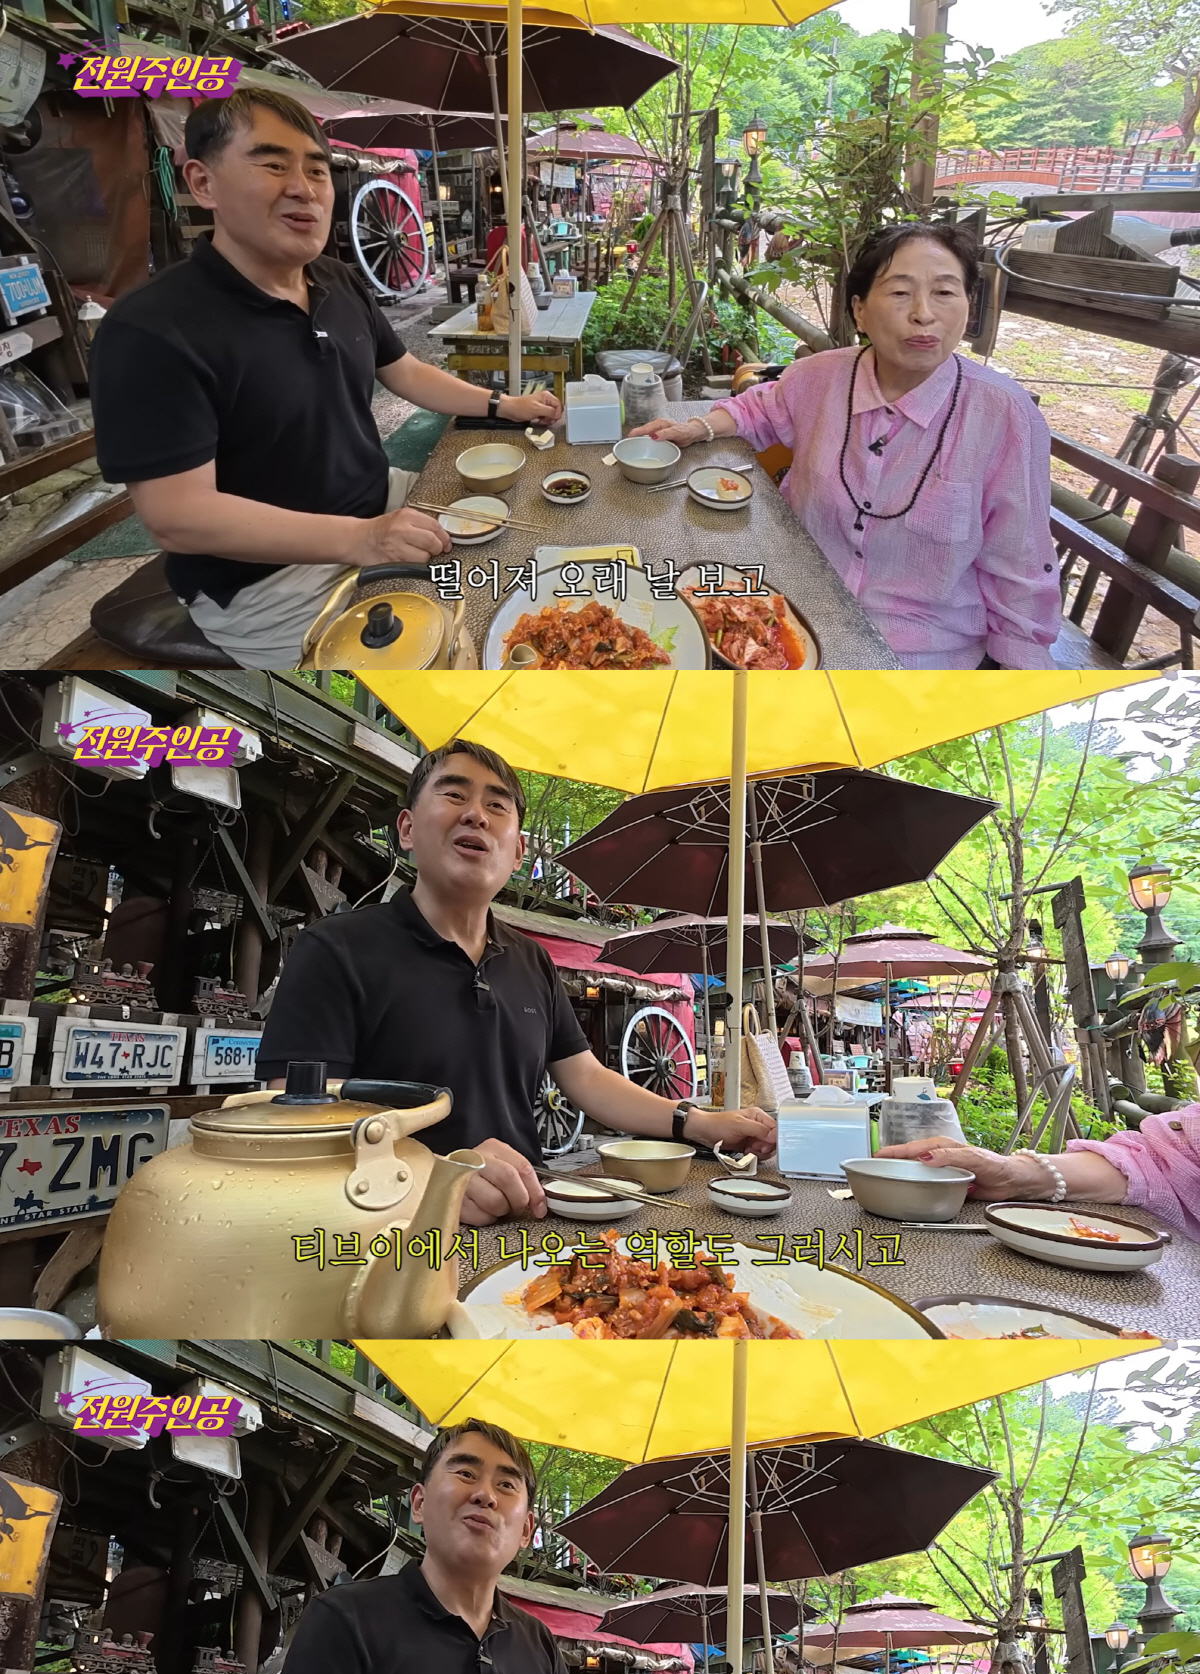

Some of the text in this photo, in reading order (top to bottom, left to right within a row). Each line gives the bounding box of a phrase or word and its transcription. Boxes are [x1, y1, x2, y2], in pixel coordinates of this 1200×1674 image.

[110, 1032, 145, 1042] TEXAS
[0, 1115, 81, 1138] EXAS
[24, 1210, 53, 1220] STAR
[59, 1204, 90, 1214] STATE
